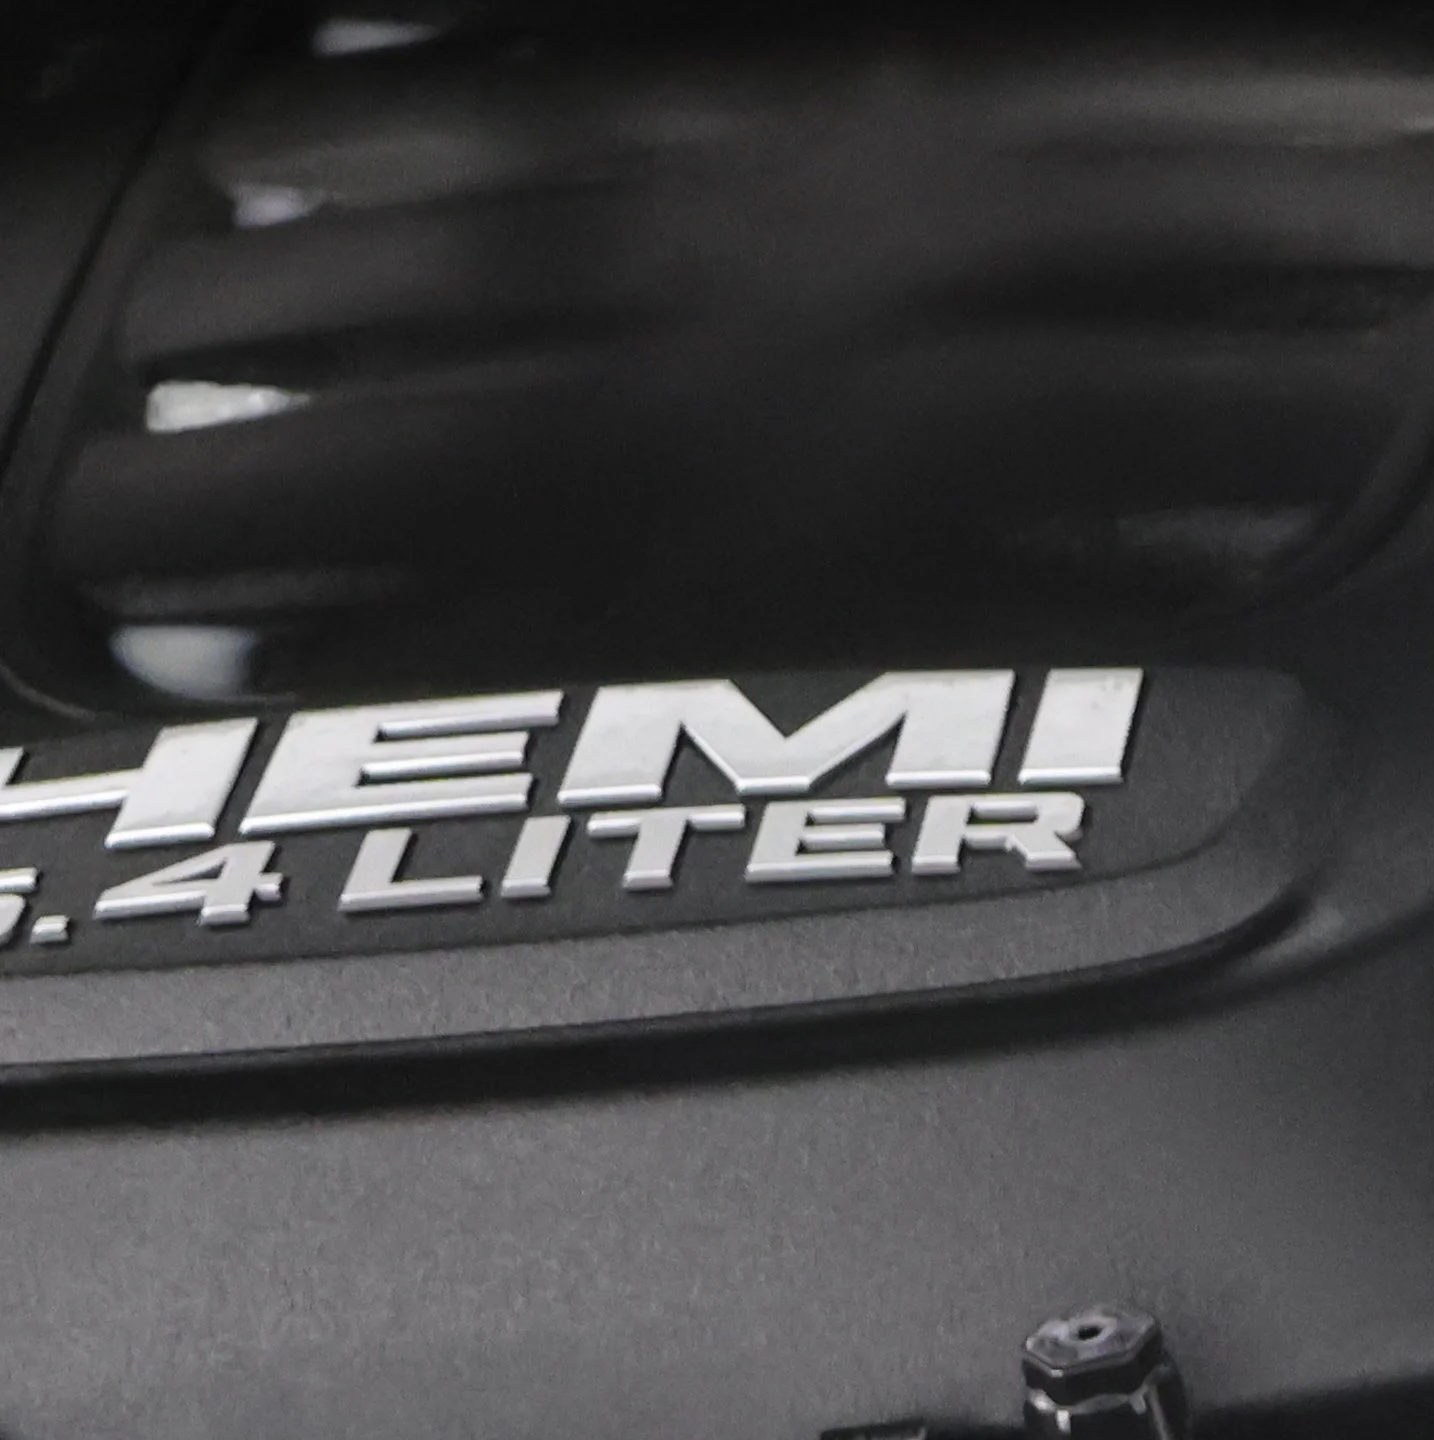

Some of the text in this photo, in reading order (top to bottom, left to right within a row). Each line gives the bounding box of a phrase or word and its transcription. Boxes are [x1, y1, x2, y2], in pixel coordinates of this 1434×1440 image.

[0, 667, 1144, 849] HEMI
[0, 792, 1086, 947] .4 LITER
